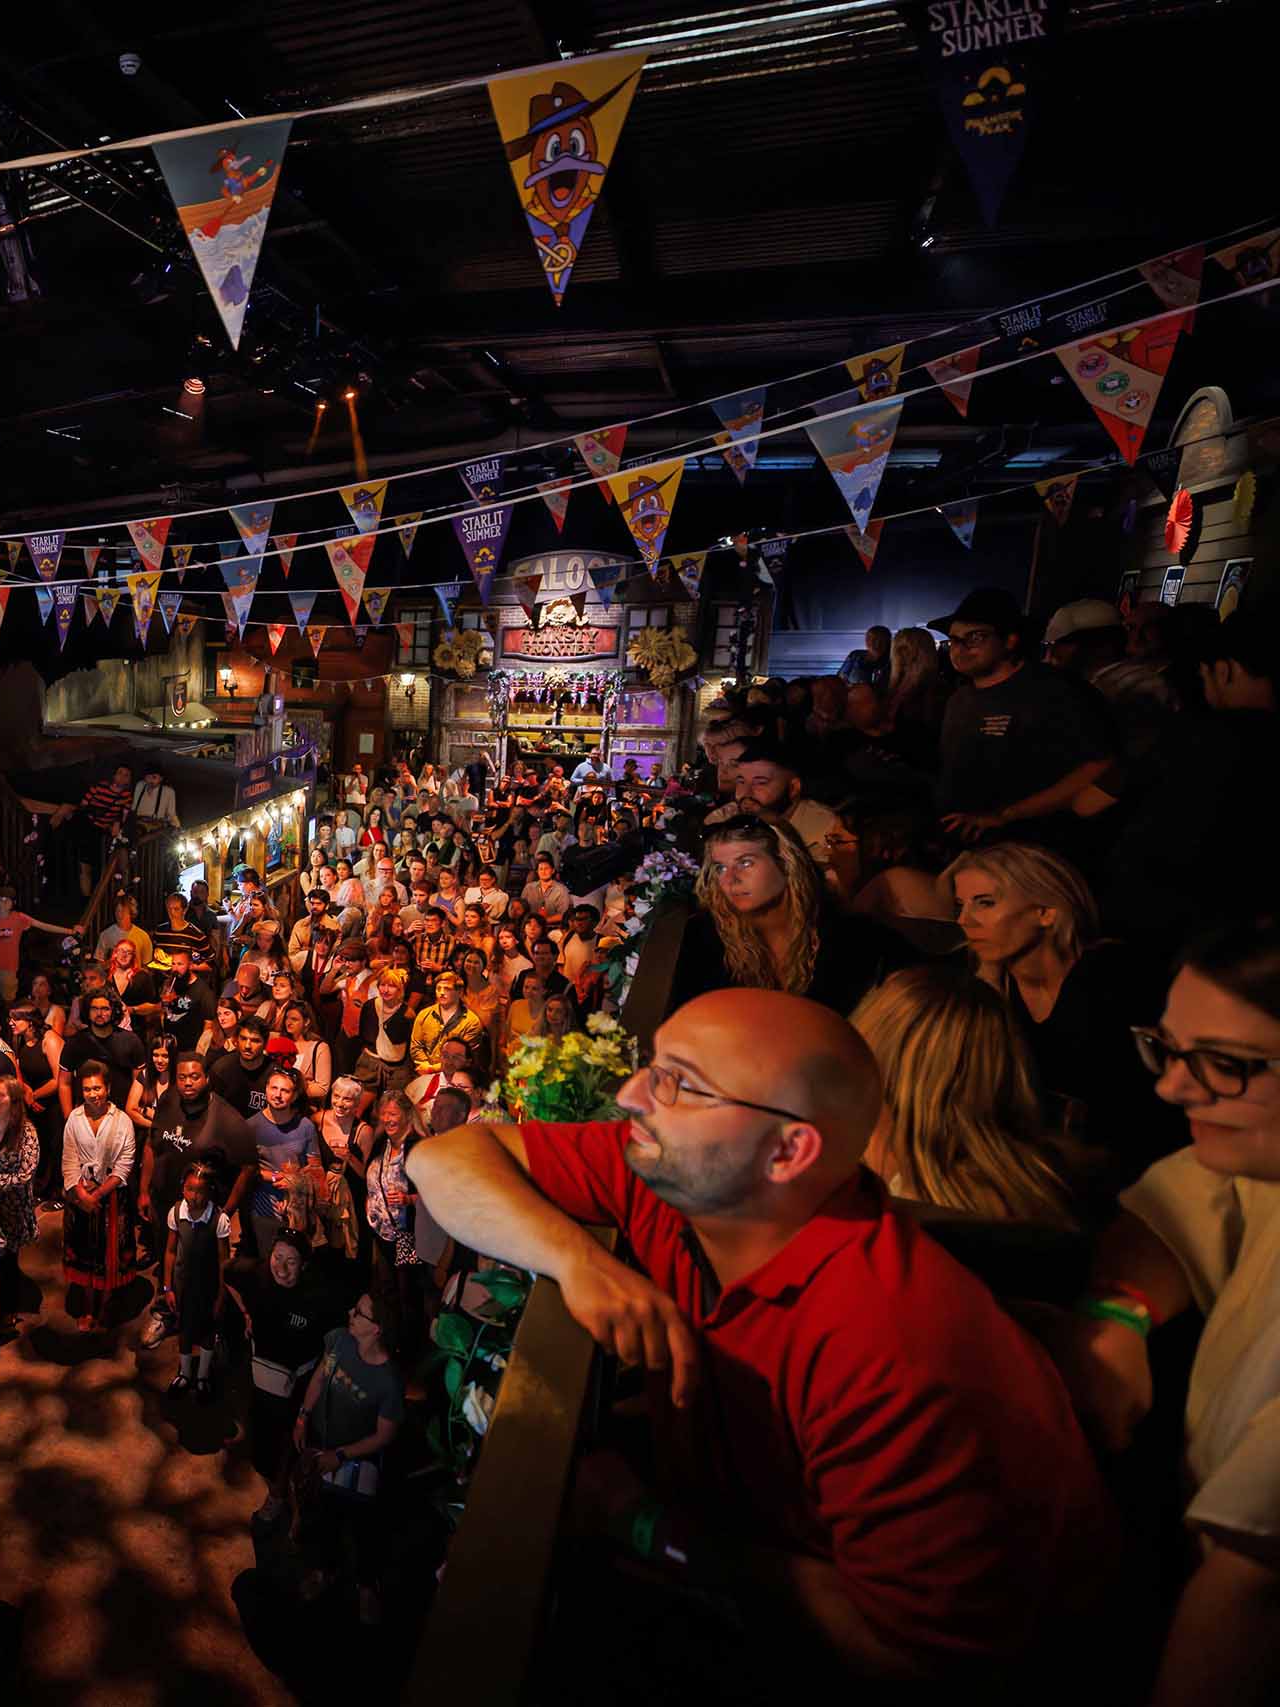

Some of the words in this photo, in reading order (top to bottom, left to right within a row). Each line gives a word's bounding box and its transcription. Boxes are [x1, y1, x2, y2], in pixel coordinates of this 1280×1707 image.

[927, 0, 1048, 32] STARL
[941, 11, 1048, 57] SUMMER
[465, 459, 500, 477] STARLIT
[462, 510, 504, 533] STARLIT
[31, 535, 60, 547] STARLIT
[466, 525, 501, 543] SUMMER
[513, 556, 621, 592] ALOO
